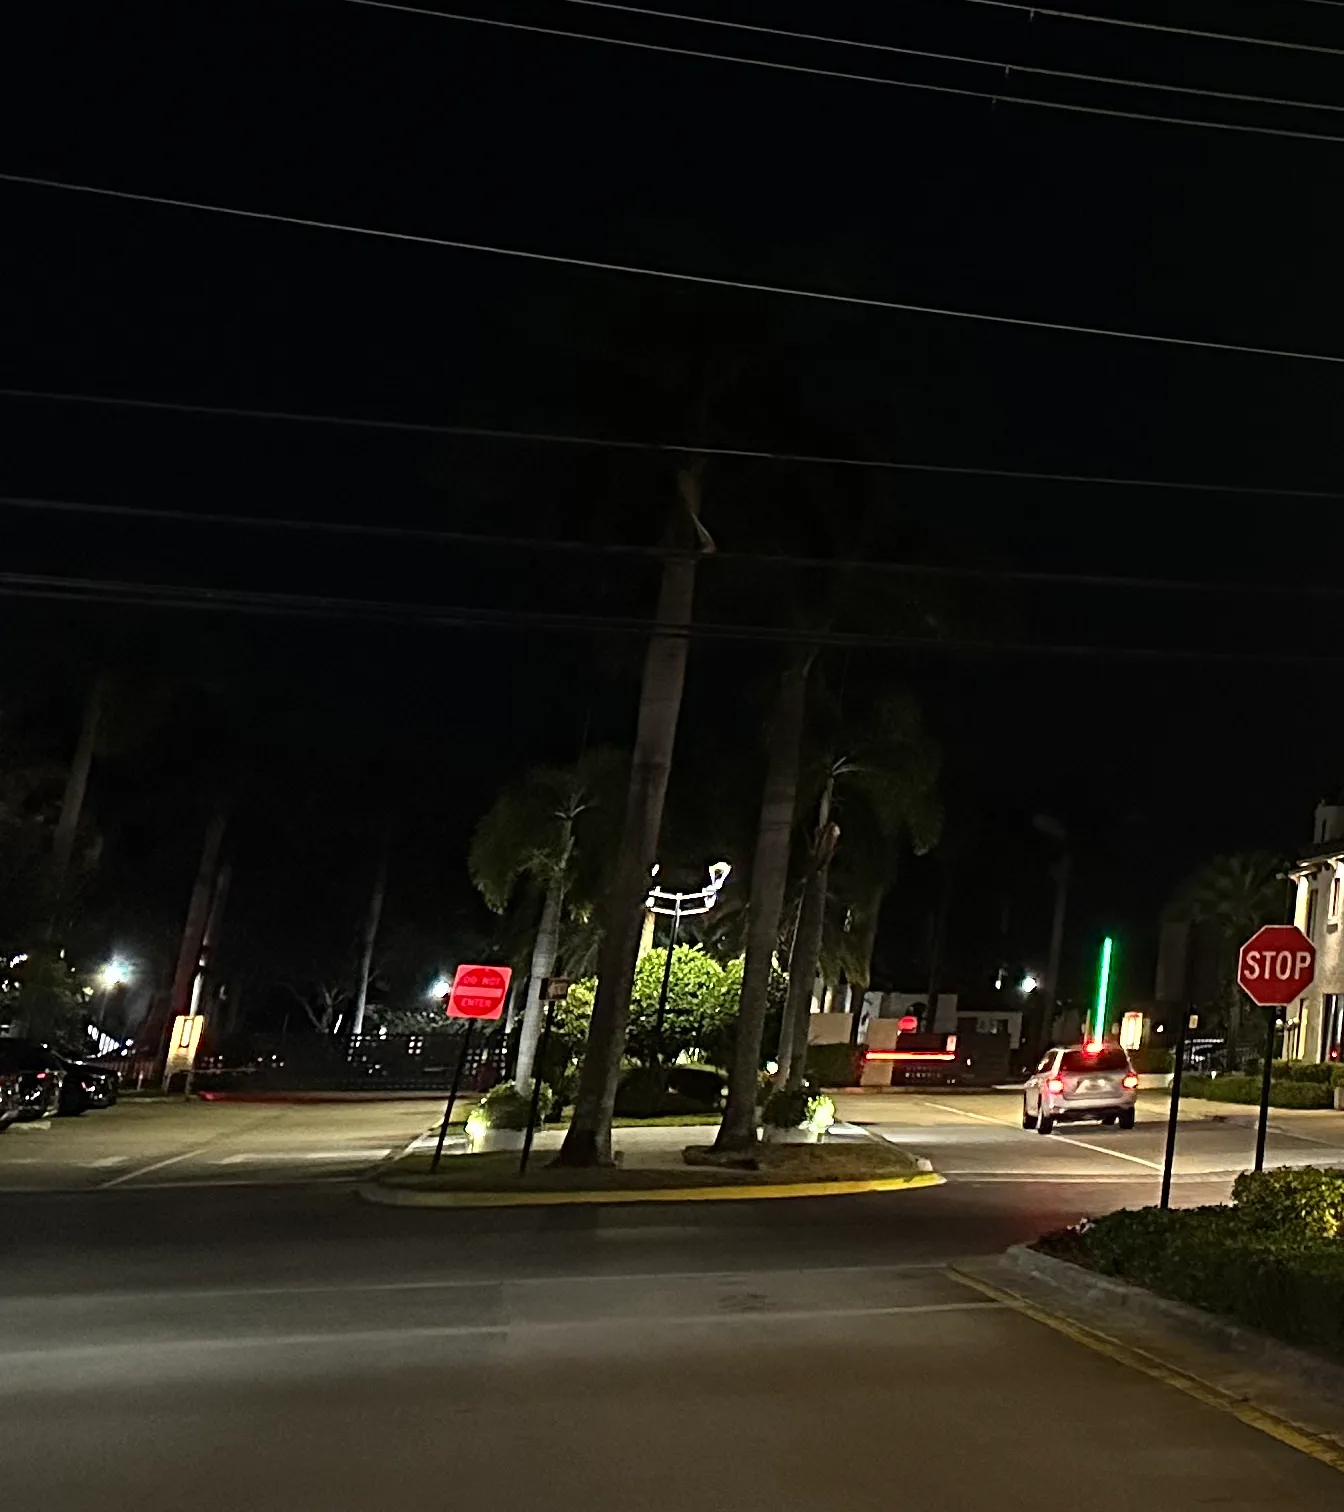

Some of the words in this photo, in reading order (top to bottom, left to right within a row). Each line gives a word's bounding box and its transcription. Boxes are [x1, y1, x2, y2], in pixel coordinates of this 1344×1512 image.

[1244, 951, 1311, 980] STOP
[463, 976, 478, 984] DO
[482, 977, 501, 985] NOT
[461, 999, 492, 1008] ENTER
